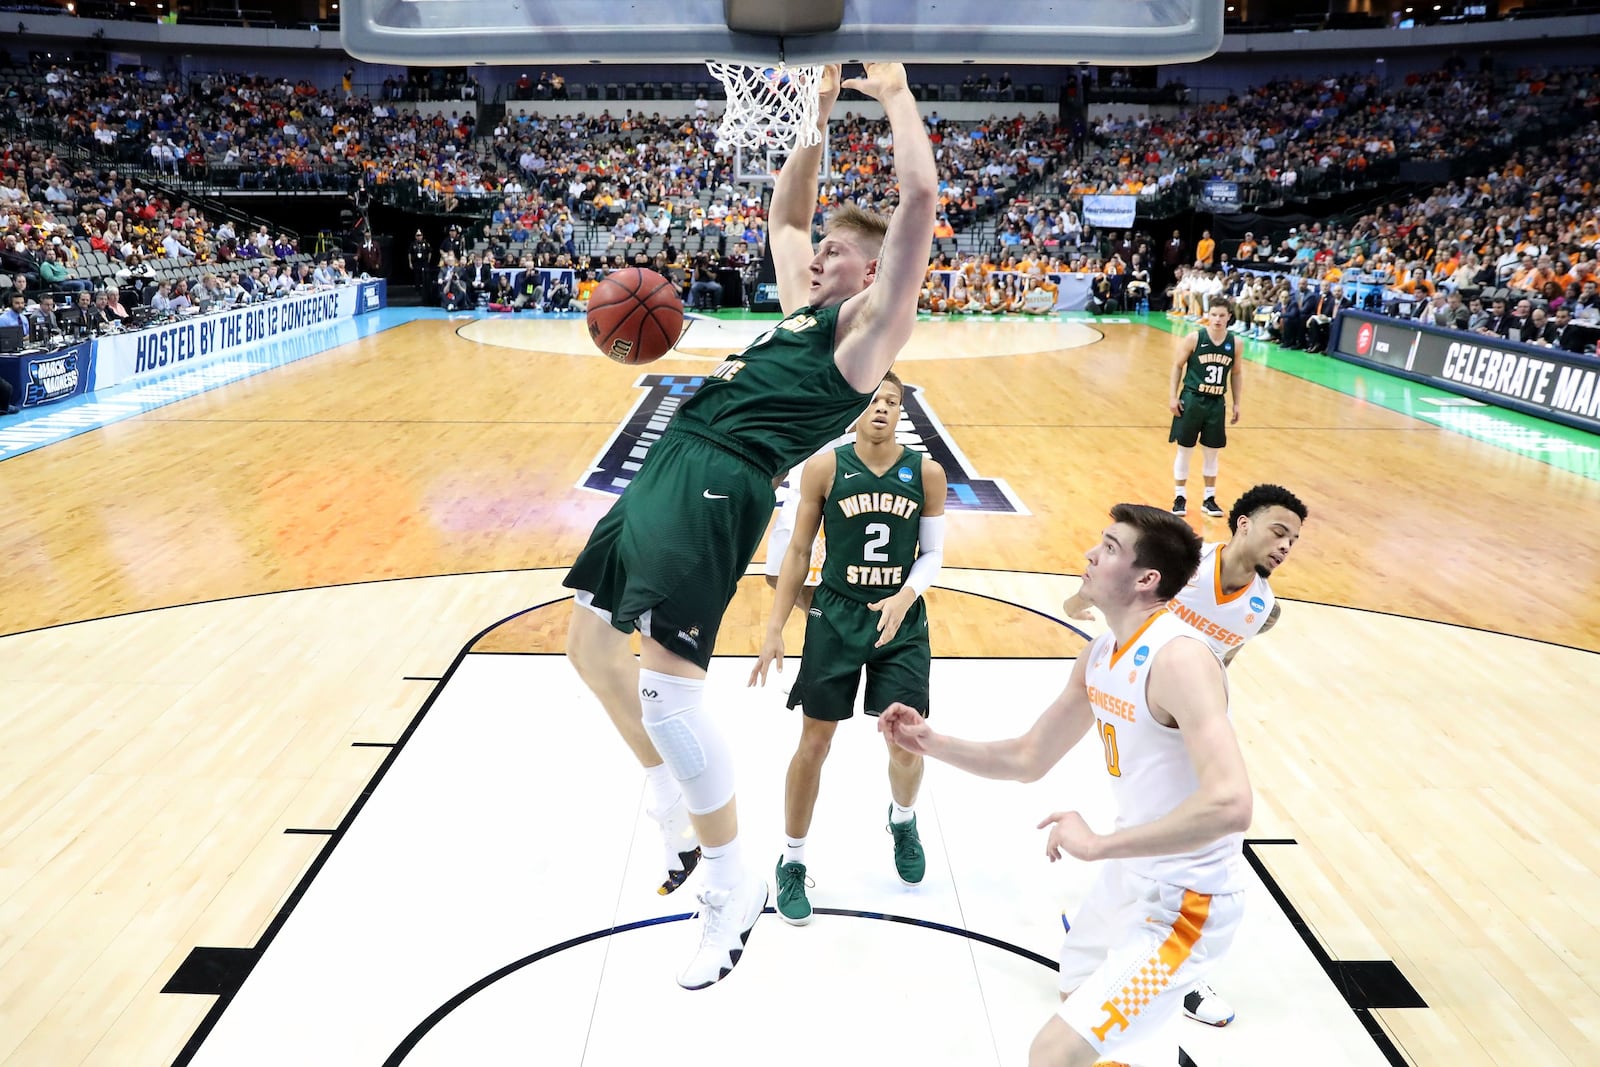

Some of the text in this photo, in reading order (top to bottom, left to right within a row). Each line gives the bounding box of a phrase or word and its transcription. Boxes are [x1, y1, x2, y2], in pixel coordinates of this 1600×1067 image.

[135, 324, 195, 373] HOSTED
[200, 320, 216, 355] BY
[220, 314, 242, 349] THE
[246, 309, 264, 342] BIG
[268, 306, 278, 337] 12
[281, 293, 339, 332] CONFERENCE
[1198, 353, 1232, 366] WRIGHT
[1204, 365, 1224, 384] 31
[1442, 342, 1600, 419] CELEBRATE MA
[1198, 383, 1224, 395] STATE
[837, 492, 919, 520] WRIGHT
[863, 522, 891, 562] 2
[846, 565, 903, 586] STATE
[1166, 597, 1245, 647] ENNESSEE
